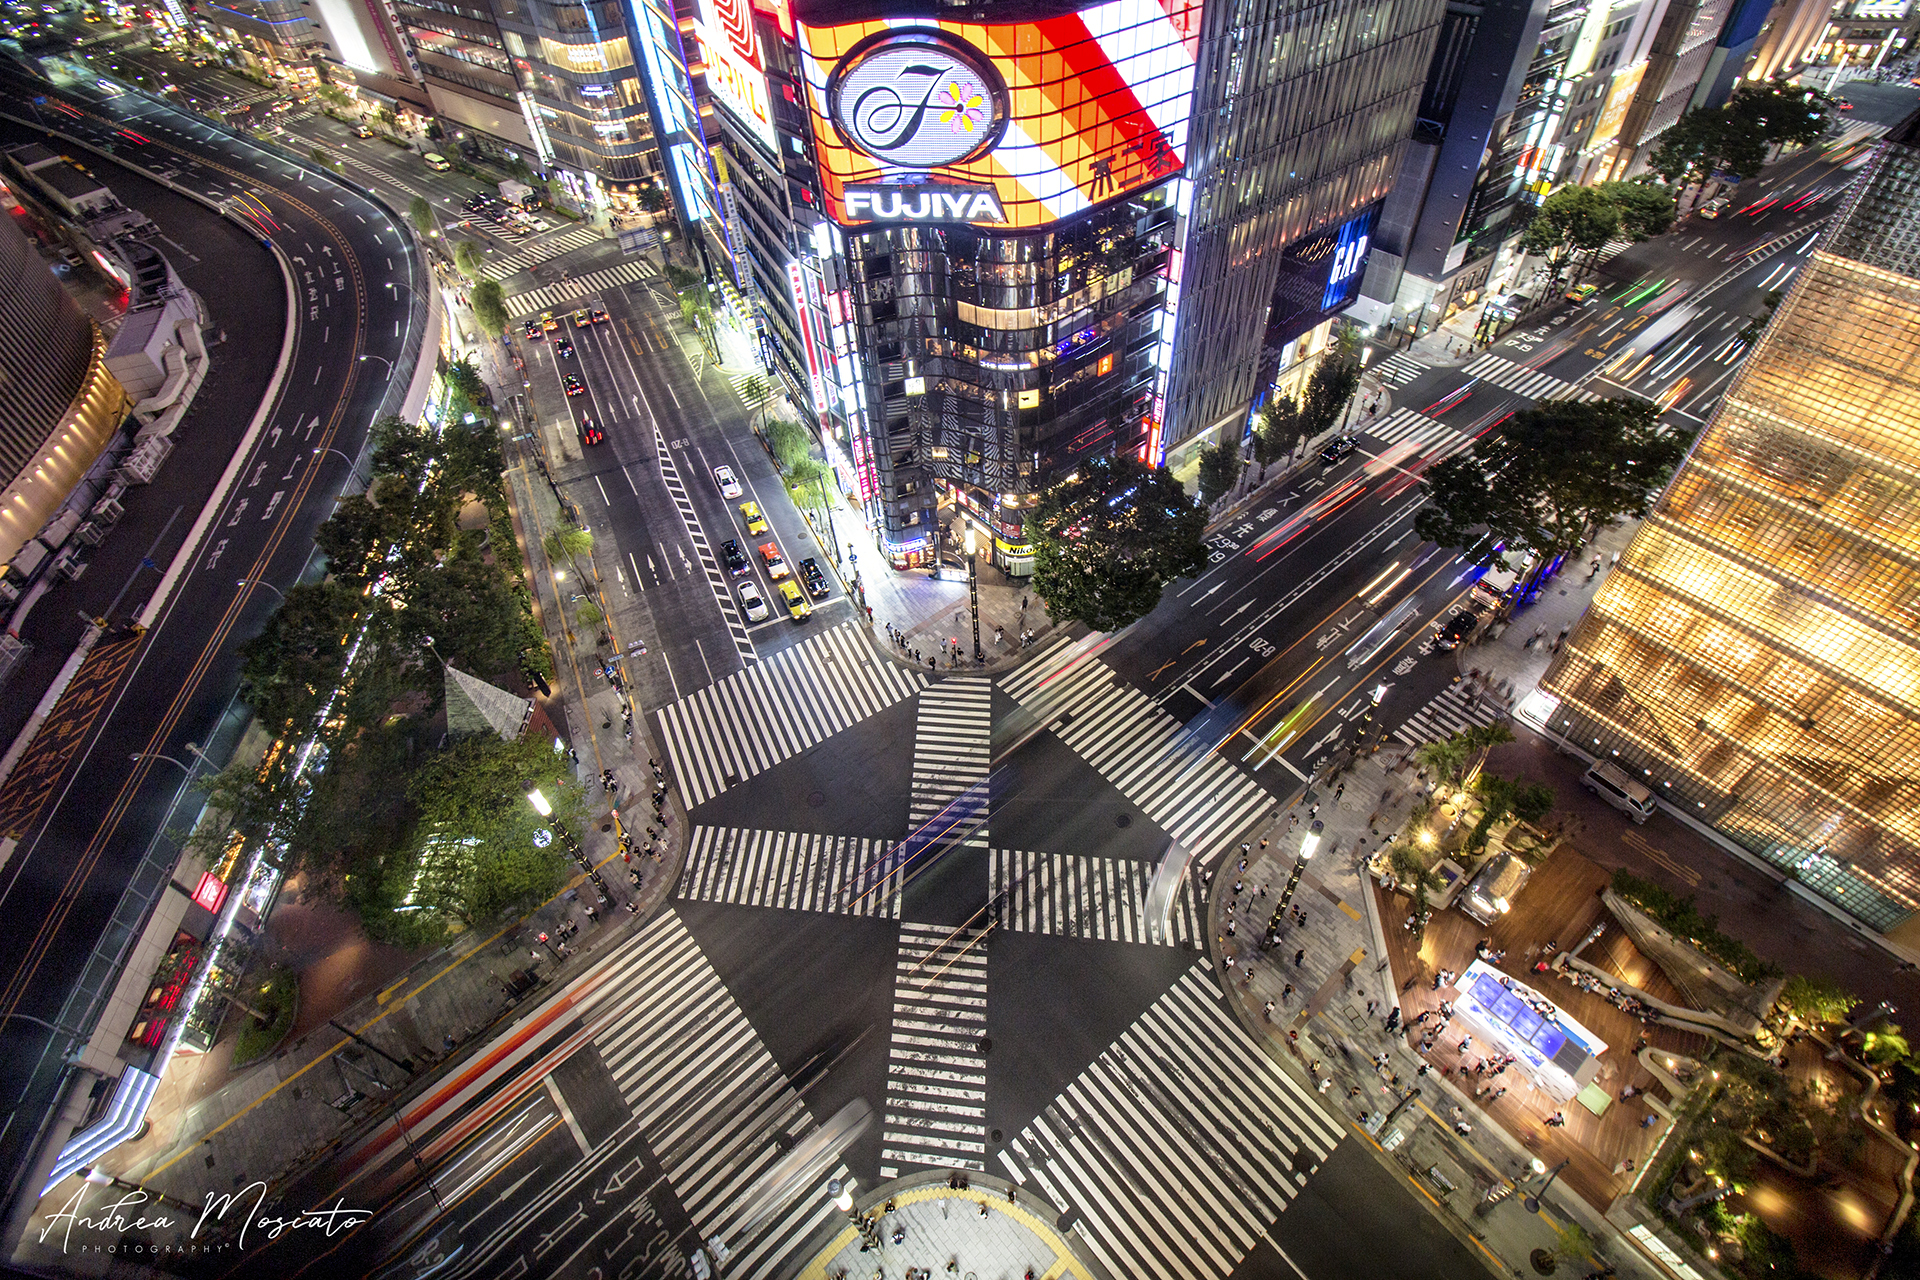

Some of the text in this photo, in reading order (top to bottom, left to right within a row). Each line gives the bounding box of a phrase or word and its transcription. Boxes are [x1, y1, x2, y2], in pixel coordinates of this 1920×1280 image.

[1088, 130, 1174, 201] 不二家
[844, 192, 1002, 219] FUJIYA
[1330, 235, 1368, 284] GAP
[1232, 477, 1325, 539] バス優先
[1249, 637, 1277, 658] 8-20
